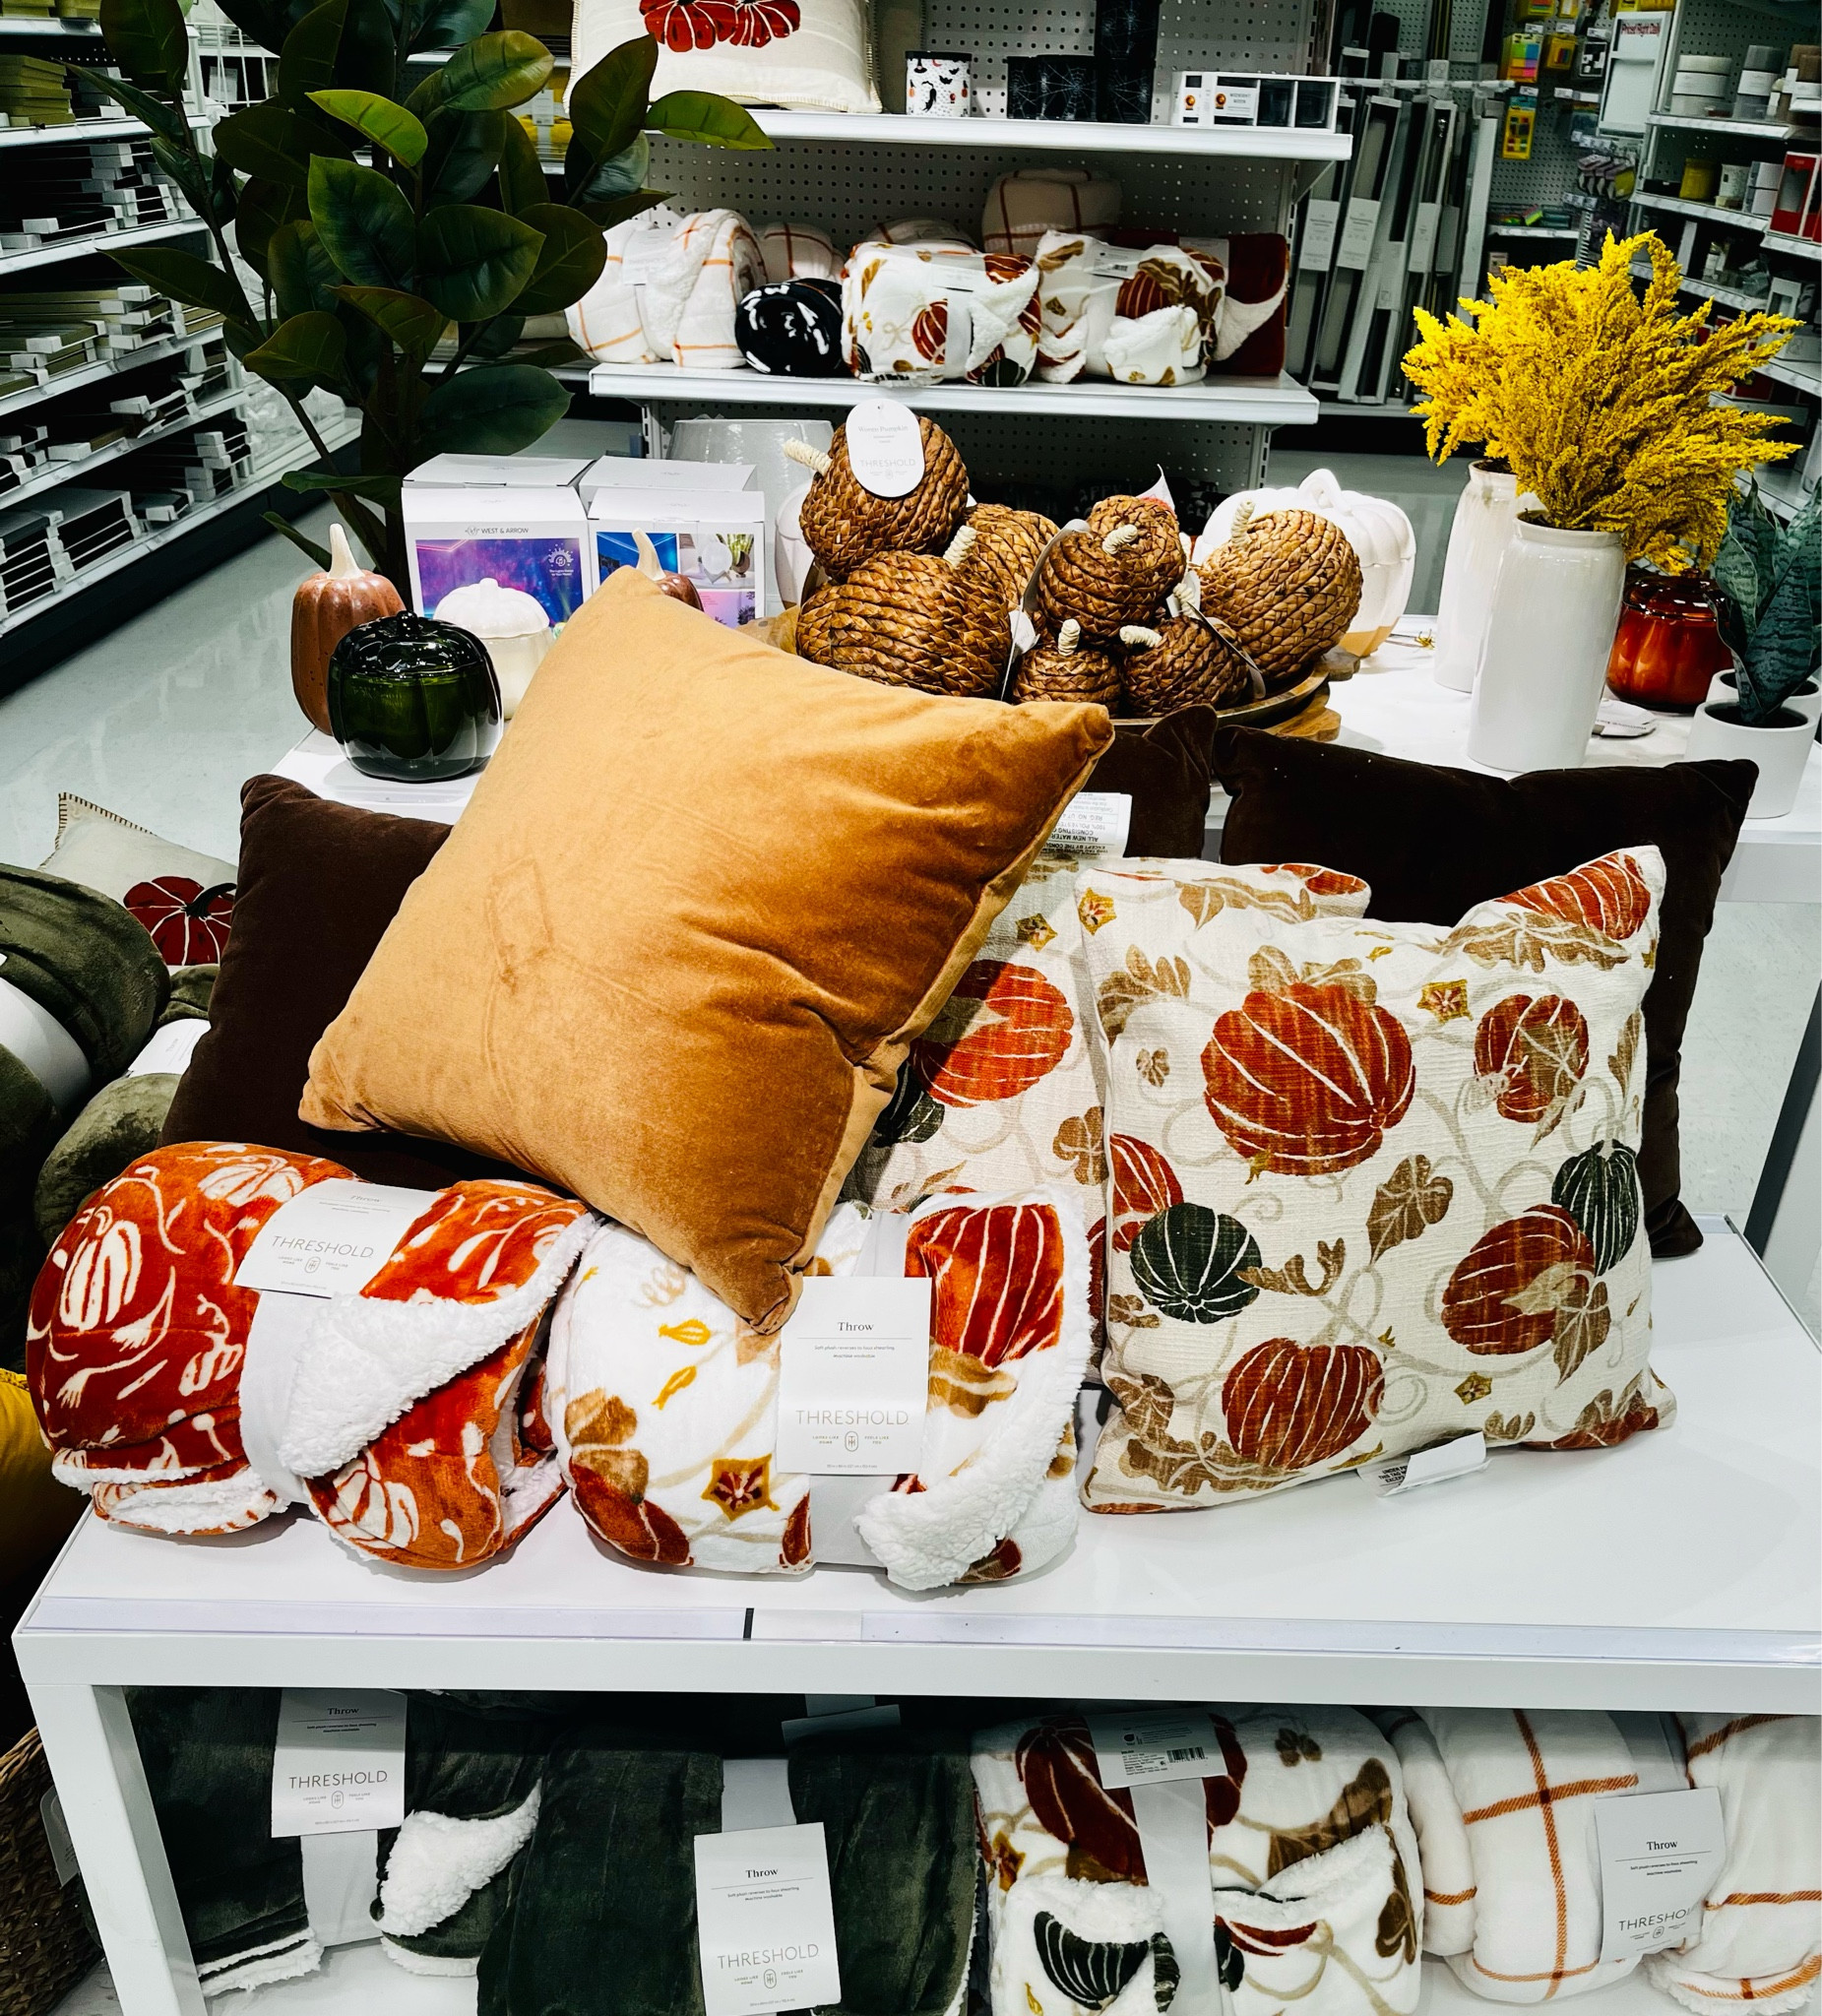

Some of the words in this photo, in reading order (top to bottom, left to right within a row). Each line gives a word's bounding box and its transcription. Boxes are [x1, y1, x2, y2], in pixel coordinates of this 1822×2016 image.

[859, 459, 915, 468] THRESHOLD
[272, 1235, 374, 1258] THRESHOLD
[838, 1322, 874, 1331] Throw
[795, 1410, 909, 1425] THRESHOLD
[288, 1770, 388, 1789] THRESHOLD
[1646, 1841, 1678, 1851] Throw
[745, 1868, 779, 1878] Throw
[1618, 1908, 1691, 1931] THRESHO
[718, 1943, 819, 1969] THRESHOLD
